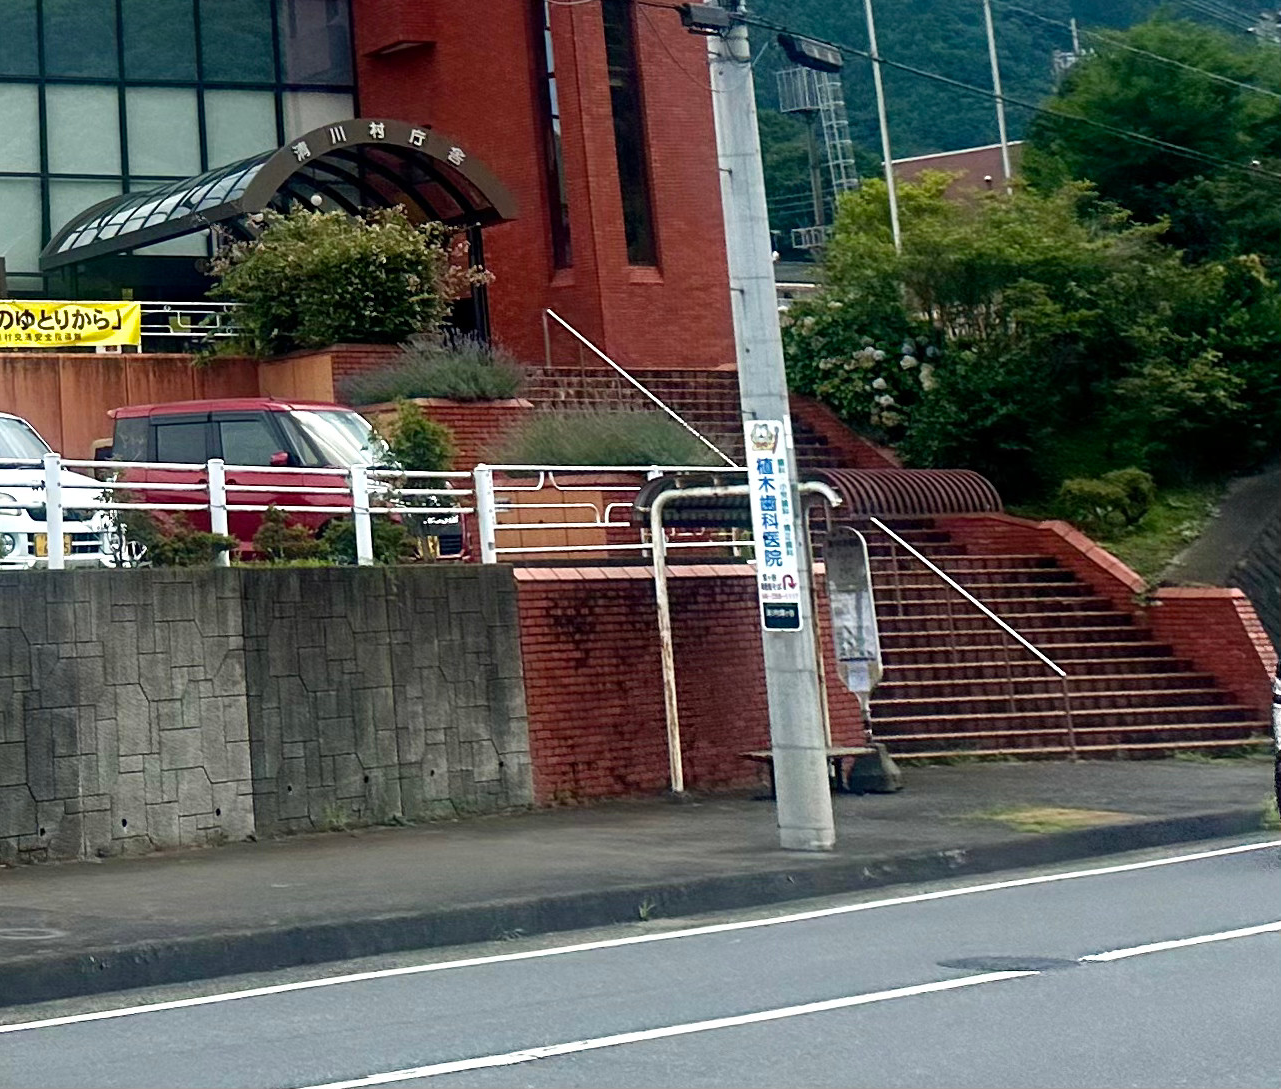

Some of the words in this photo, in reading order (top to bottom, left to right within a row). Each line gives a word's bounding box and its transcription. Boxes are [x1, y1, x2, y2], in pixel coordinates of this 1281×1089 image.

[291, 121, 467, 167] 清川村庁舎
[756, 457, 783, 567] 植木歯科医院
